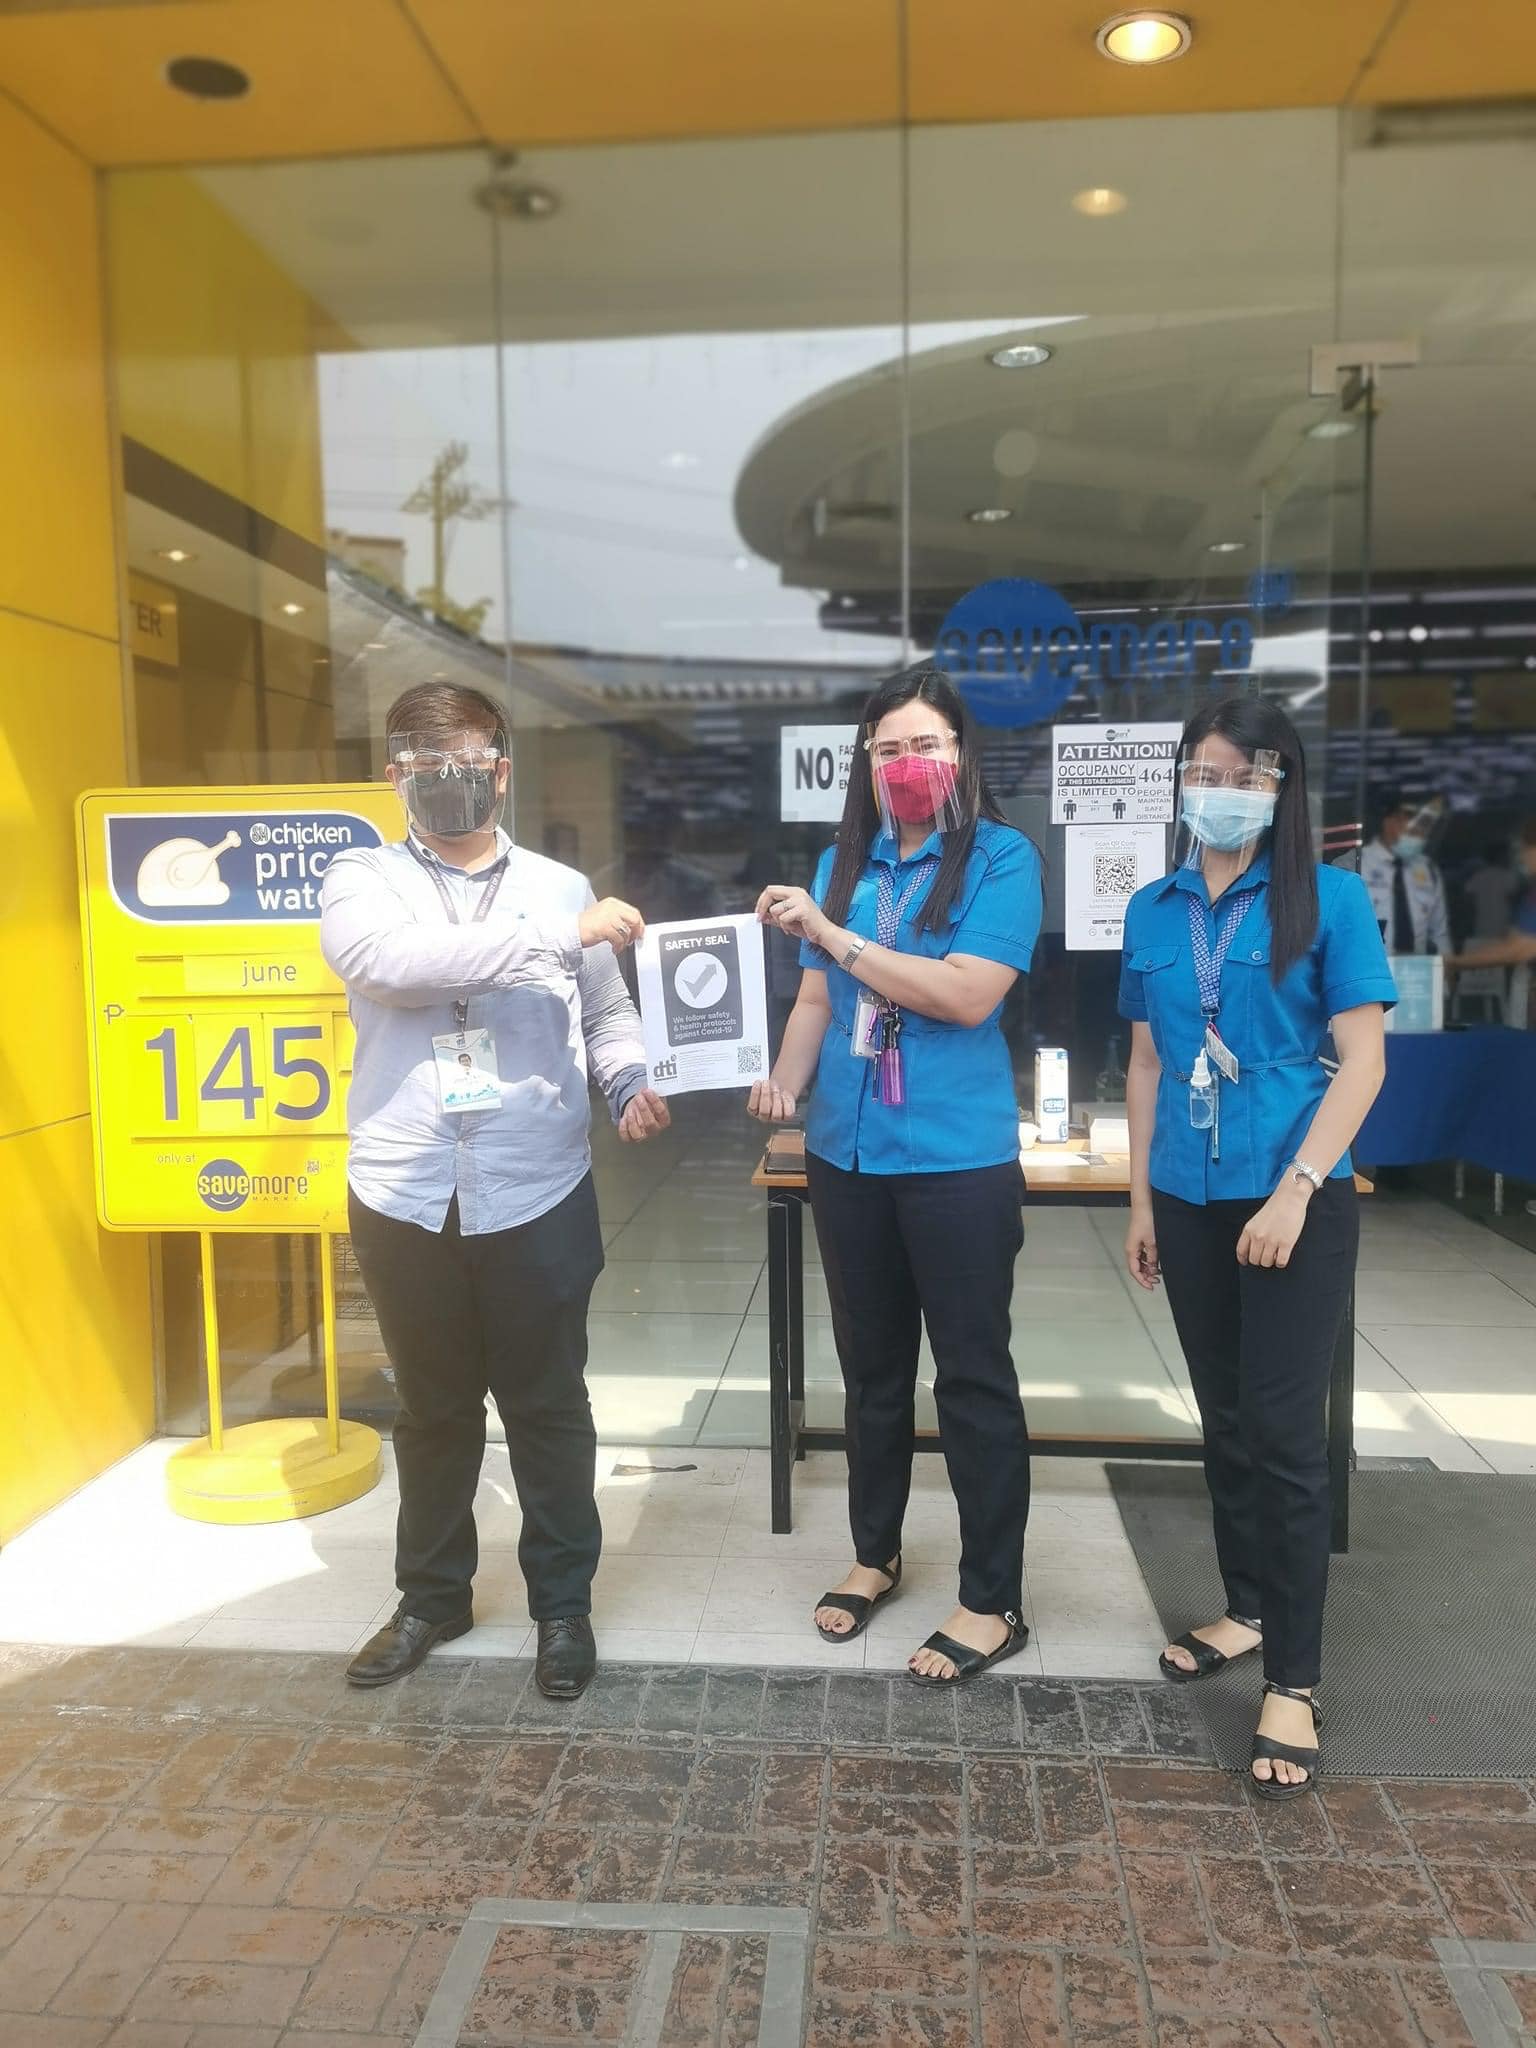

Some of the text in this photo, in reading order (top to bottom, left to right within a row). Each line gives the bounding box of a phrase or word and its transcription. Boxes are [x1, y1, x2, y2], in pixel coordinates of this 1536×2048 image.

[1062, 743, 1173, 759] ATTENTION!
[795, 747, 834, 790] NO
[1058, 764, 1135, 777] OCCUPANCY
[1138, 767, 1174, 783] 464
[1058, 787, 1136, 797] IS LIMITED TO
[272, 822, 352, 844] chicken
[665, 934, 731, 951] SAFETY SEAL
[242, 961, 298, 987] june
[680, 1022, 702, 1031] health
[703, 1018, 737, 1029] protocols
[685, 1014, 707, 1022] follow
[708, 1011, 730, 1020] safety
[145, 1025, 331, 1121] 145
[157, 1152, 196, 1165] only at
[198, 1173, 309, 1197] savemore
